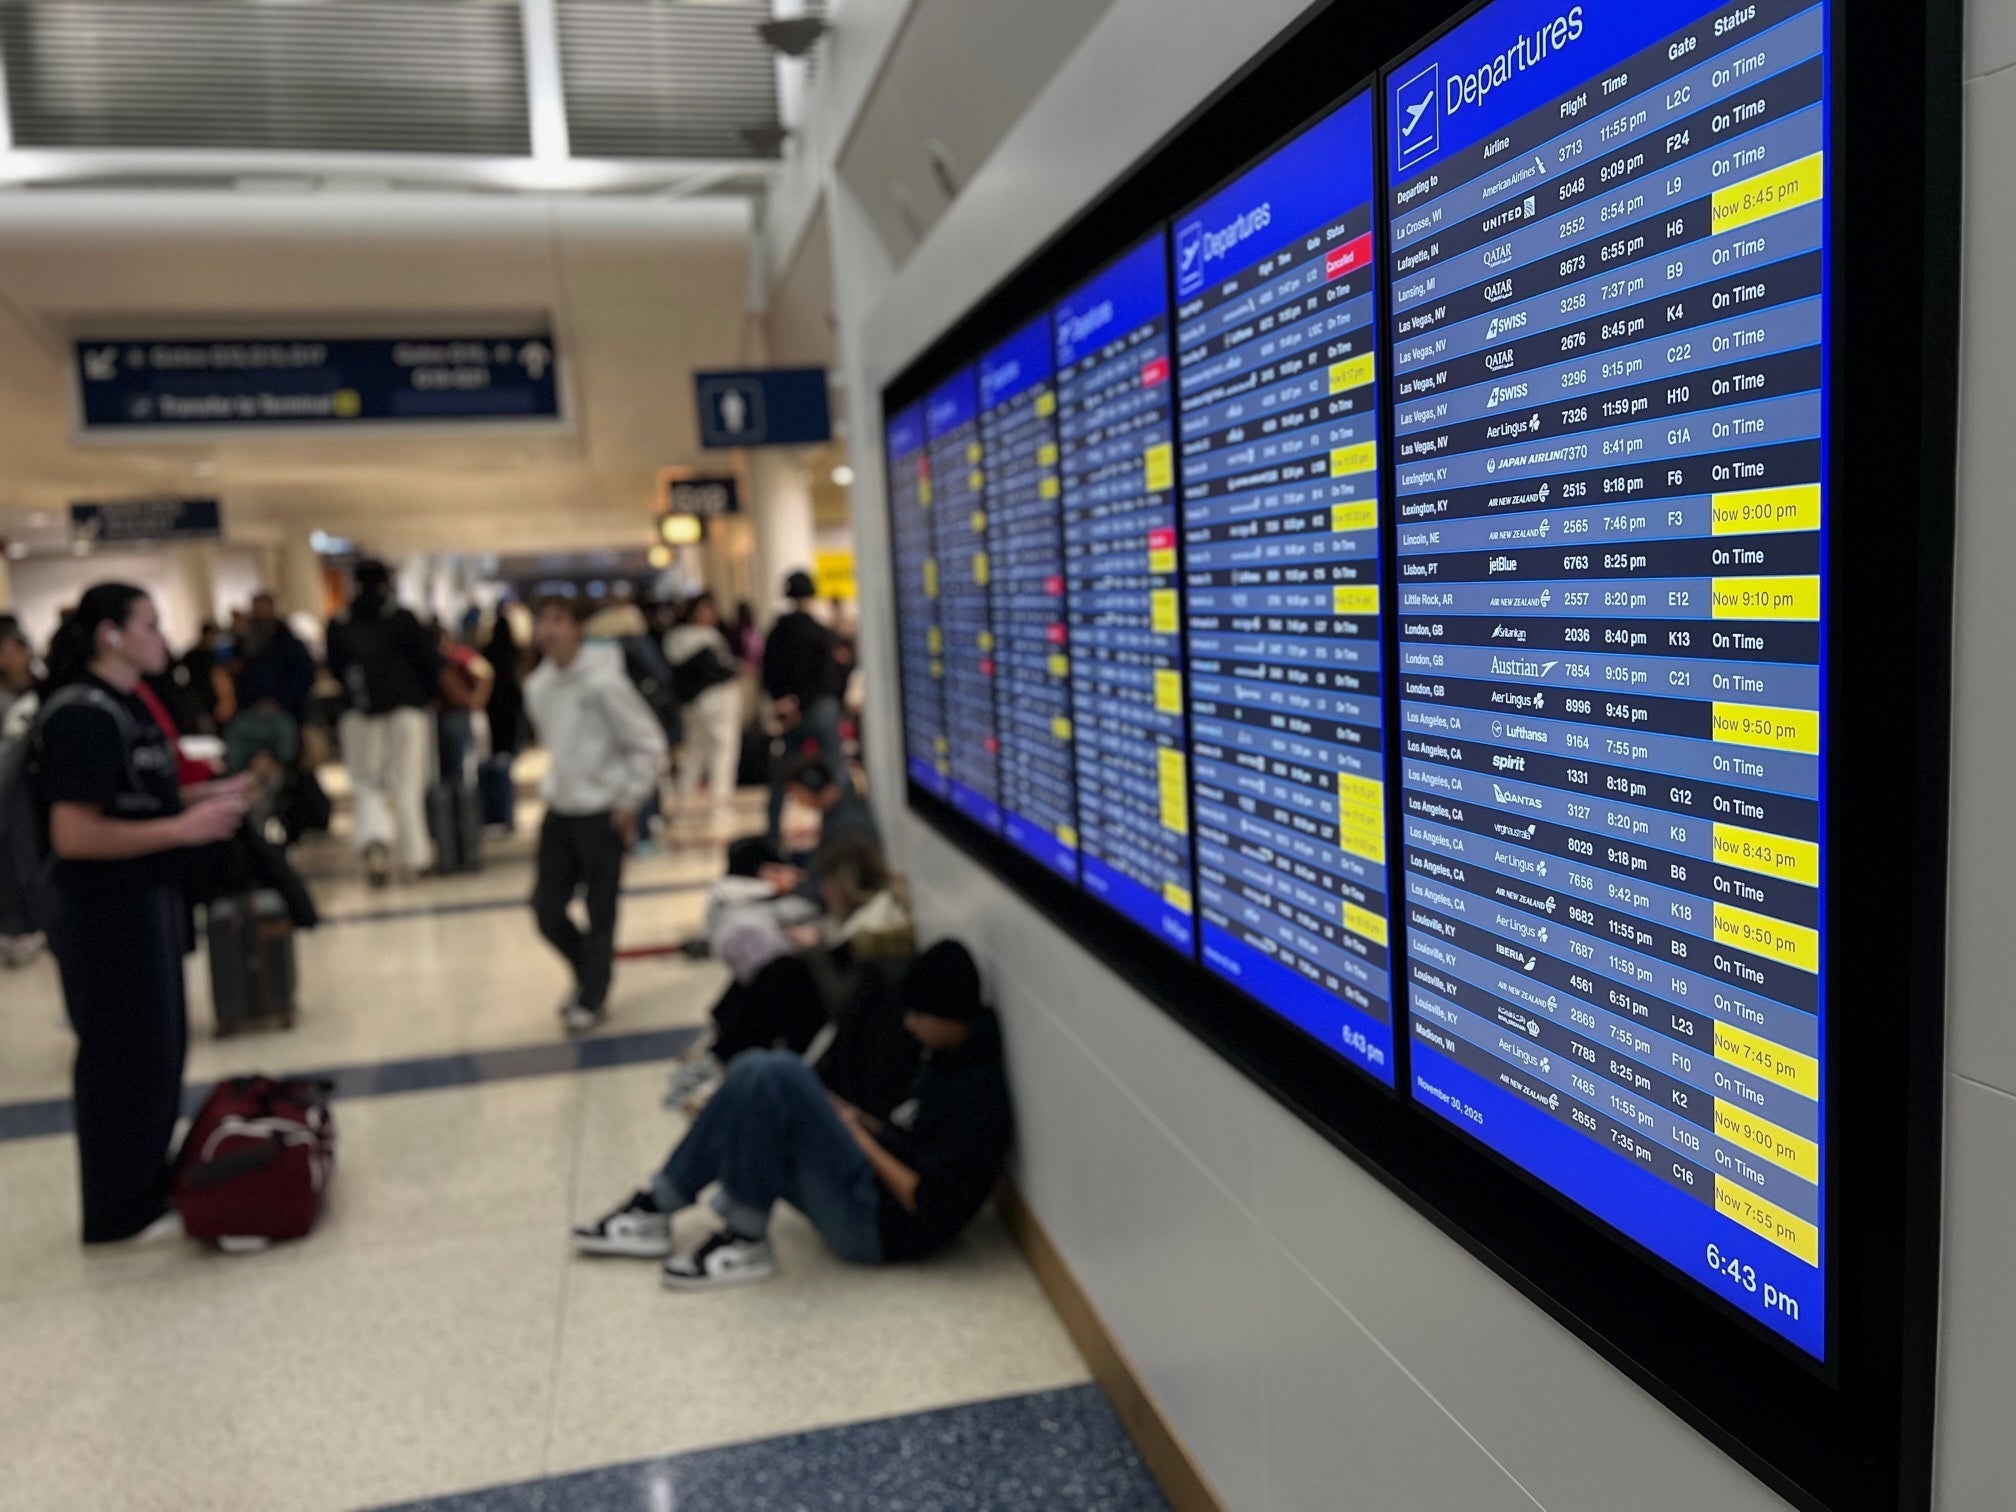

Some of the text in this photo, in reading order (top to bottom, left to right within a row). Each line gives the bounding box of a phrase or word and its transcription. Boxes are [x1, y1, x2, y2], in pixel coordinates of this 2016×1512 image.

[1397, 5, 1756, 205] Departing to Airline Flight Time Gate Status
[1447, 5, 1584, 116] Departures
[1396, 226, 1406, 240] La
[1406, 218, 1432, 236] Crosse,
[1432, 208, 1442, 223] WI
[1558, 139, 1584, 163] 3713
[1600, 117, 1627, 142] 11:55
[1630, 110, 1648, 132] pm
[1666, 86, 1692, 111] L2C
[1712, 69, 1730, 88] On
[1733, 52, 1767, 78] Time
[1397, 99, 1766, 272] Lafayette, IN UNITED 5048 9:09 pm F24 On Time
[1203, 203, 1271, 262] Departures
[1326, 250, 1354, 273] Cancelled
[1399, 180, 1799, 334] Las Vegas, NV QATAR 8673 6:55 pm H6 Now 8:45 pm
[1401, 330, 1765, 426] Las Vegas, NV SWISS 3296 9:15 pm C22 On Time
[1403, 548, 1764, 577] Lisbon, PT jetBlue 6763 8:25 pm On Time
[1404, 594, 1421, 606] Little
[1422, 594, 1441, 607] Rock,
[1441, 594, 1453, 606] AR
[1564, 592, 1590, 606] 2557
[1604, 592, 1628, 607] 8:20
[1631, 595, 1648, 610] pm
[1669, 592, 1689, 606] E12
[1713, 592, 1738, 606] Now
[1743, 592, 1769, 607] 9:10
[1774, 595, 1794, 608] pm
[1405, 653, 1764, 693] London, GB Austrian 7854 9:05 pm C21 On Time
[1407, 740, 1764, 820] Los Angeles, CA spirit 1331 8:18 pm G12 On Time
[1410, 826, 1422, 839] Los
[1422, 830, 1452, 850] Angeles,
[1452, 838, 1464, 852] CA
[1569, 872, 1593, 891] 7656
[1608, 884, 1632, 903] 9:42
[1633, 894, 1650, 908] pm
[1671, 903, 1692, 922] K18
[1715, 915, 1739, 936] Now
[1743, 924, 1772, 946] 9:50
[1776, 937, 1796, 953] pm
[1412, 910, 1796, 1080] Louisville, KY IBERIA 4561 6:51 pm L23 Now 7:45 pm
[1342, 1024, 1384, 1066] 6:43 pm
[1415, 995, 1447, 1022] Louisville,
[1447, 1011, 1458, 1025] KY
[1571, 1074, 1595, 1097] 7485
[1610, 1095, 1636, 1118] 11:55
[1638, 1111, 1654, 1128] pm
[1672, 1126, 1700, 1152] L10B
[1714, 1149, 1732, 1169] On
[1735, 1158, 1765, 1186] Time
[1416, 1022, 1445, 1049] Madison,
[1445, 1038, 1455, 1053] WI
[1572, 1108, 1596, 1131] 2655
[1610, 1129, 1634, 1152] 7:35
[1636, 1145, 1652, 1163] pm
[1673, 1164, 1694, 1186] C16
[1716, 1187, 1741, 1212] Now
[1744, 1202, 1773, 1230] 7:55
[1777, 1224, 1796, 1244] pm
[1417, 1076, 1484, 1125] November 30, 2025
[1706, 1244, 1799, 1322] 6:43 pm
